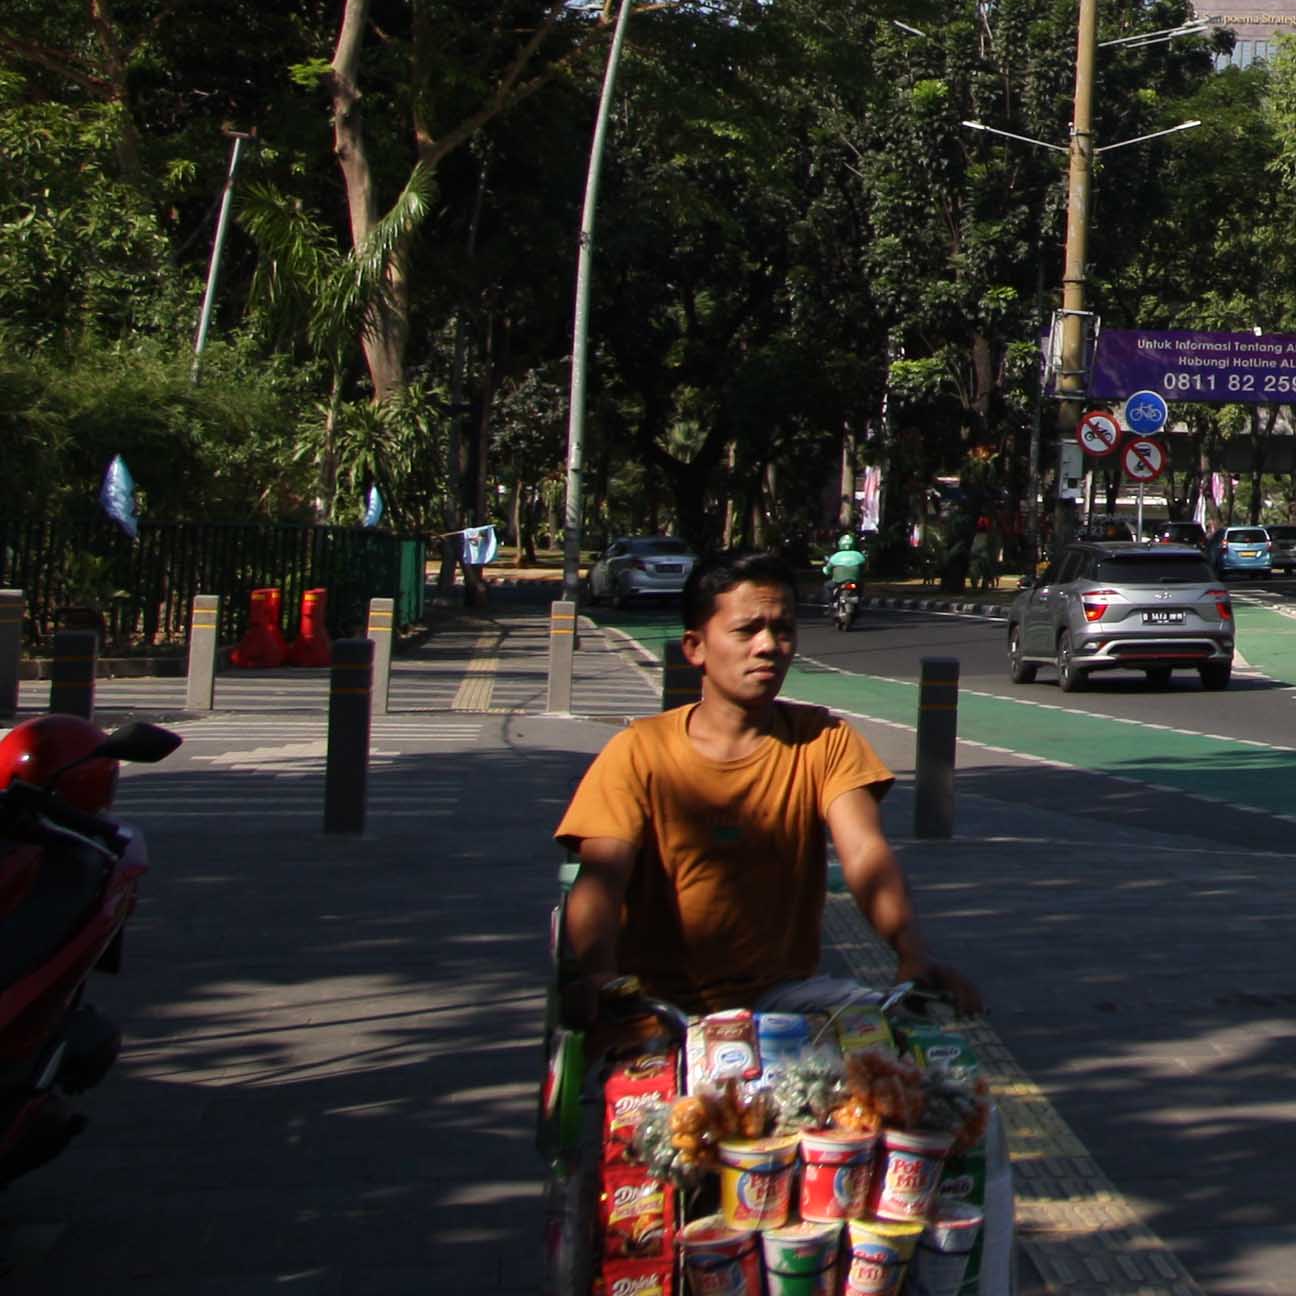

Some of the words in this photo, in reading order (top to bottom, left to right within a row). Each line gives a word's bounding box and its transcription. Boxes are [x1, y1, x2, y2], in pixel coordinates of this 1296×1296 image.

[1137, 339, 1172, 350] Untuk
[1175, 340, 1231, 352] Informasi
[1234, 342, 1282, 354] Tentang
[1178, 357, 1230, 369] Hubungi
[1163, 373, 1216, 390] 0811
[1228, 374, 1255, 391] 82
